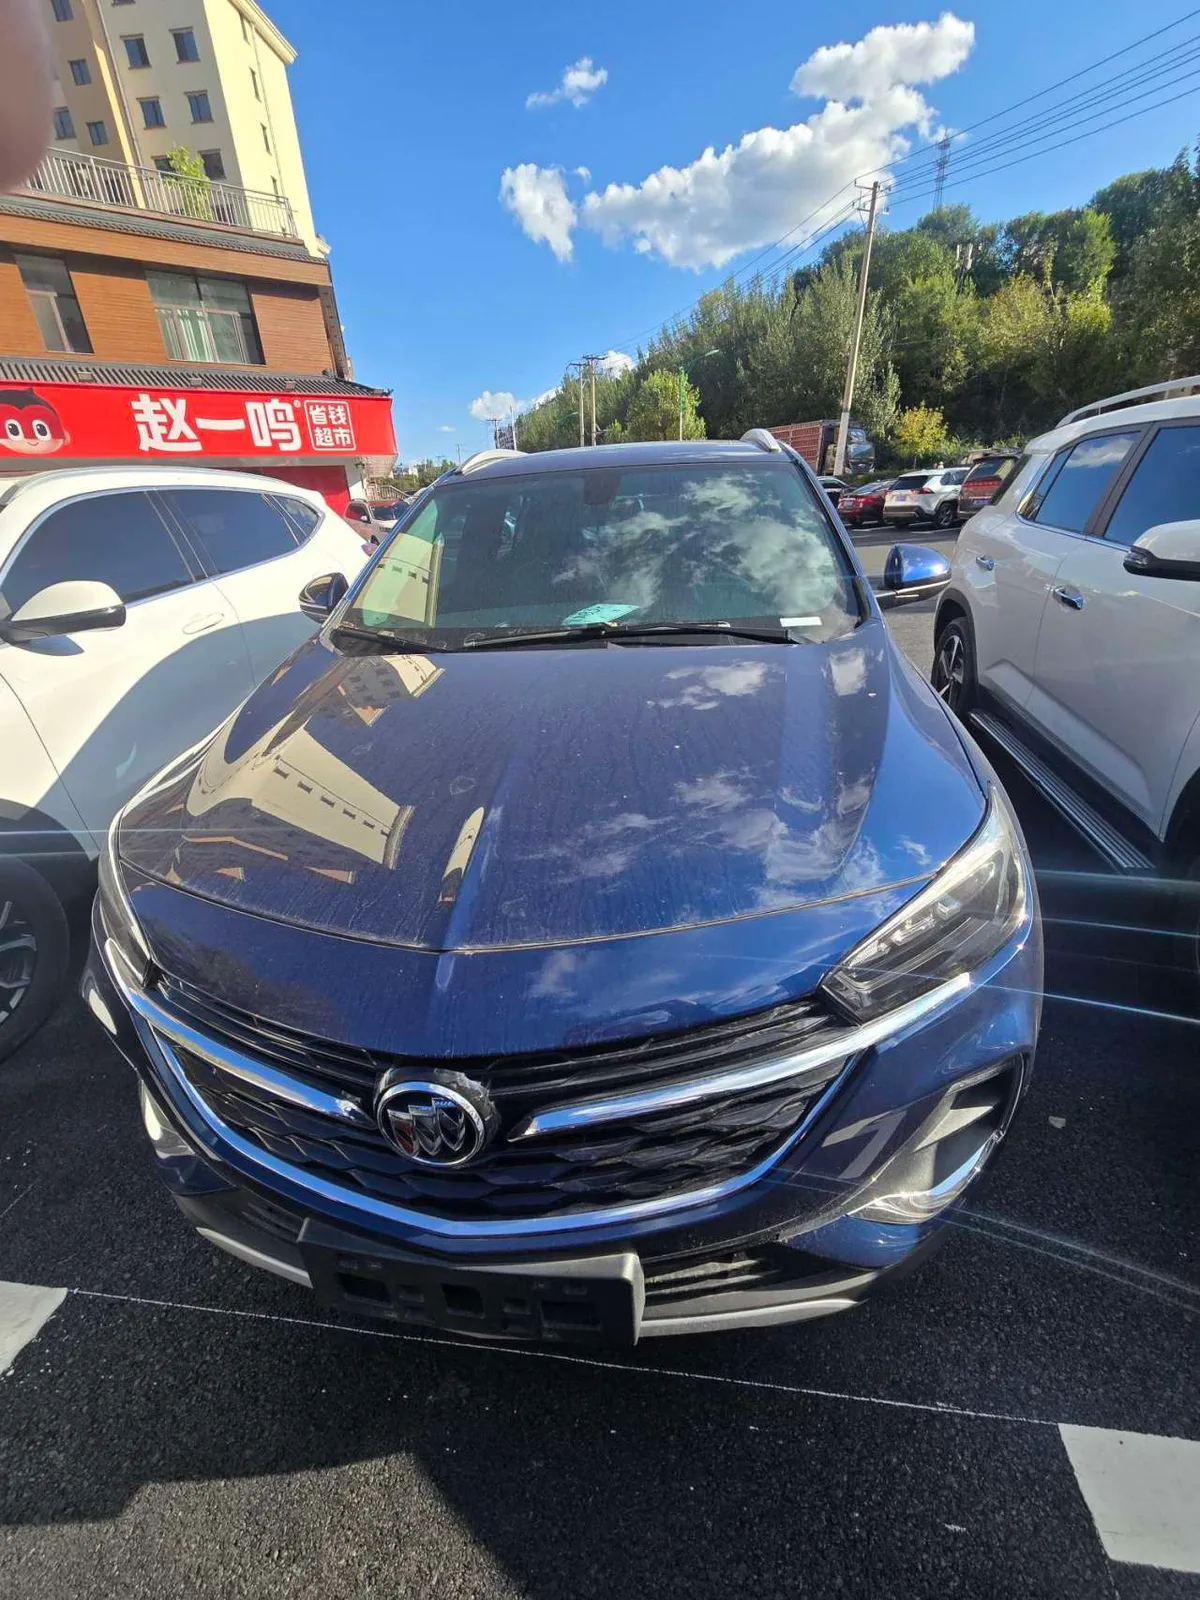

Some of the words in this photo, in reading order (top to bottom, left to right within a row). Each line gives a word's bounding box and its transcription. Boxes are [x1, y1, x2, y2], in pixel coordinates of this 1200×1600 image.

[131, 394, 302, 451] 赵一鸣
[309, 404, 347, 425] 省钱
[314, 426, 351, 447] 超市
